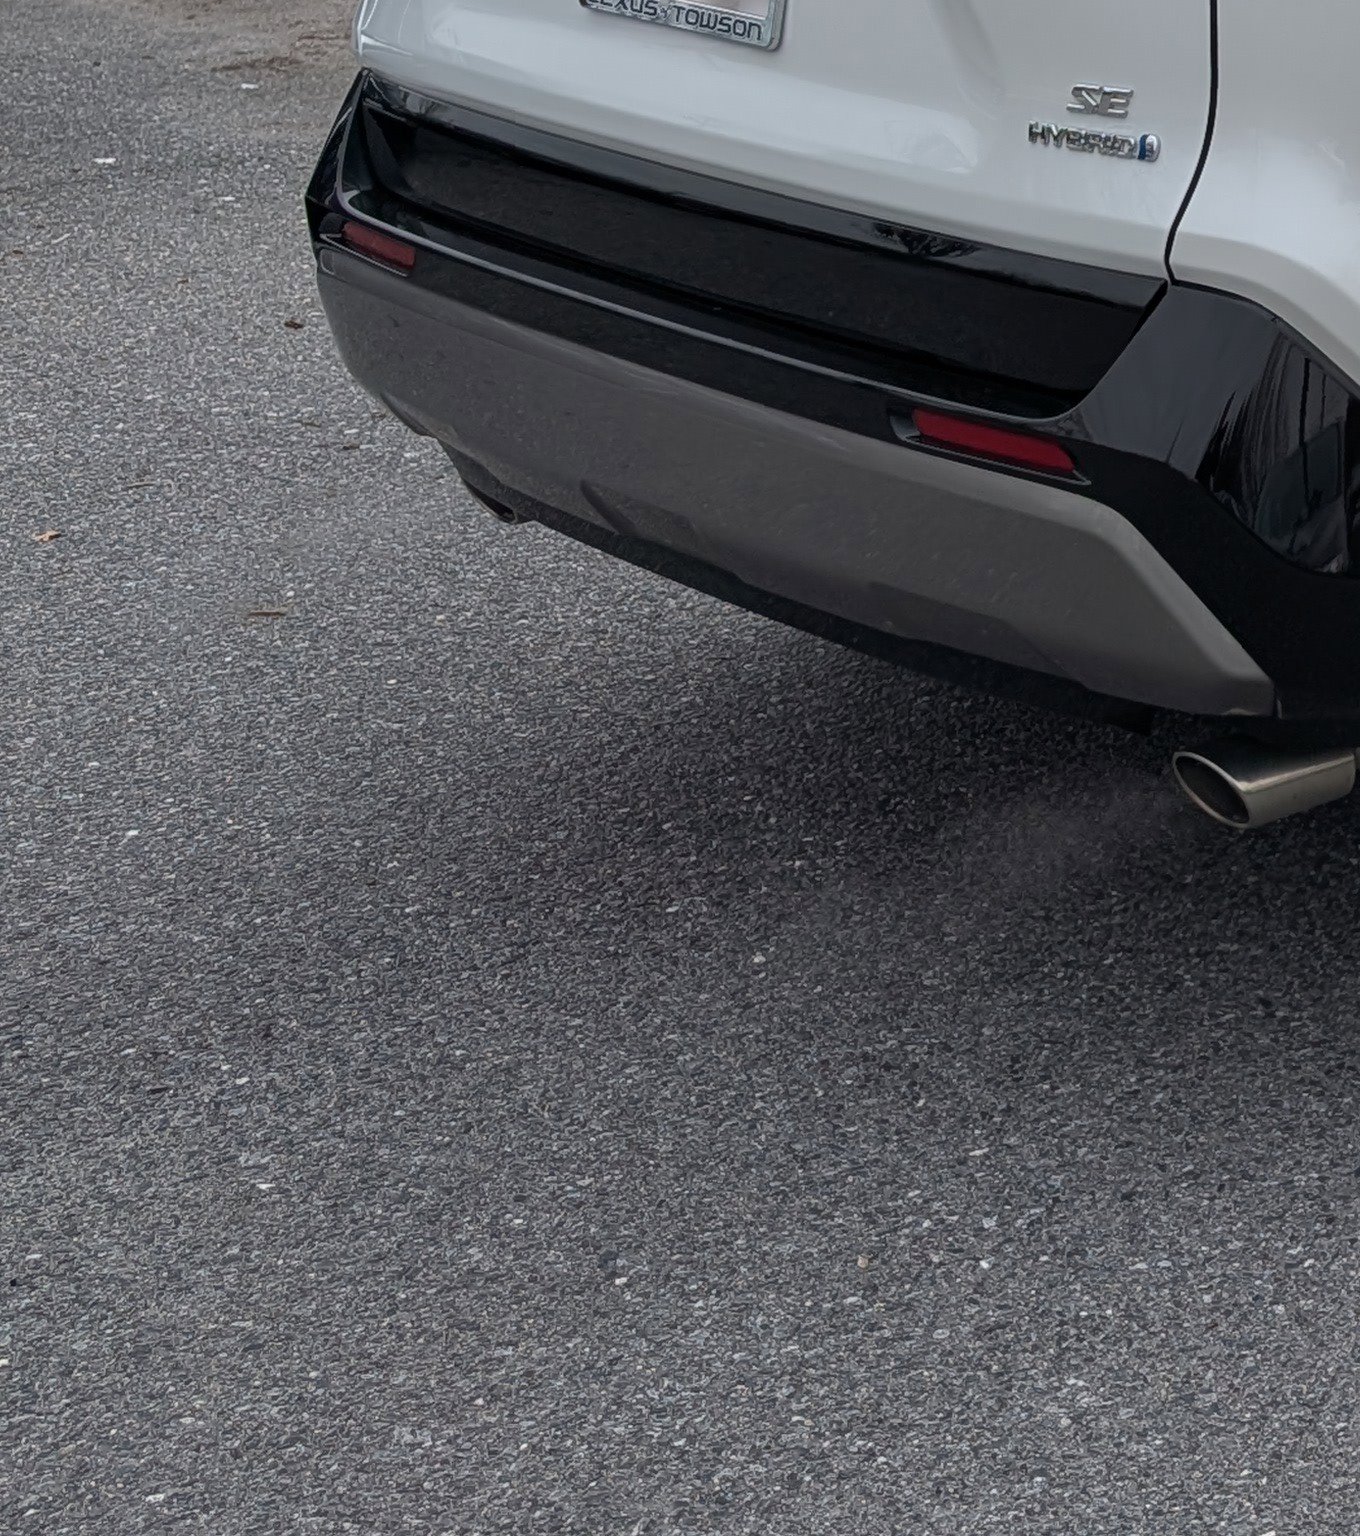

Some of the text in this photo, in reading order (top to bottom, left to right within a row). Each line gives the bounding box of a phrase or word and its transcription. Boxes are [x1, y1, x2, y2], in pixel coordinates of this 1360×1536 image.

[671, 4, 763, 41] TOWSON
[1065, 82, 1135, 119] SE
[1028, 119, 1139, 161] HYBRID
